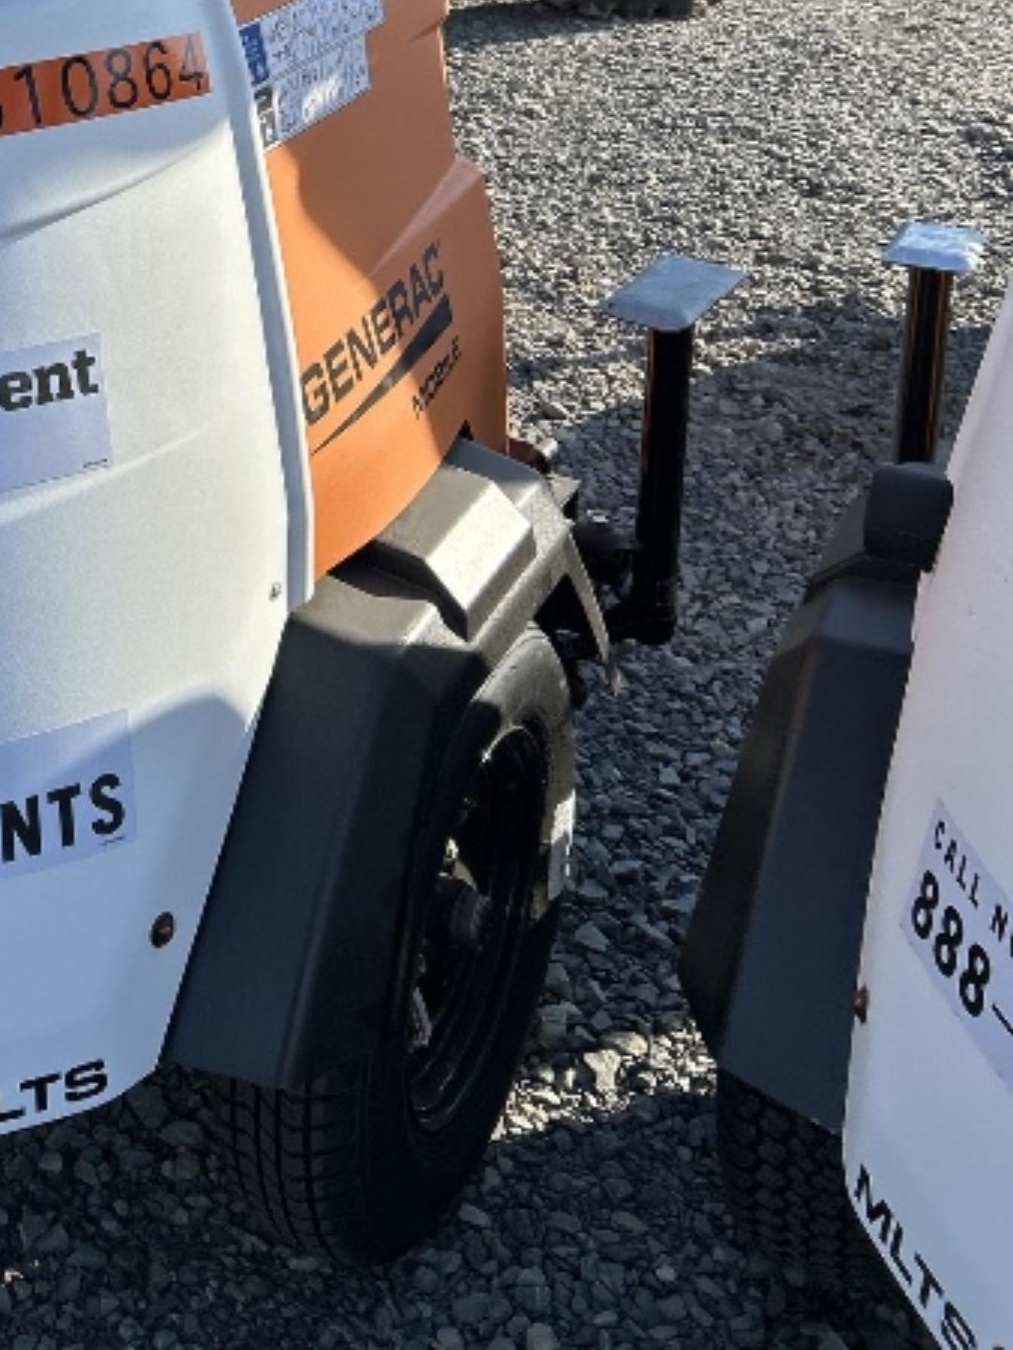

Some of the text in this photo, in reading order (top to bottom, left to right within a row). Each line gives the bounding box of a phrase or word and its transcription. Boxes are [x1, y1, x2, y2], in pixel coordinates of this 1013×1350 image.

[303, 243, 444, 424] GENERAC
[933, 820, 980, 910] CALL
[854, 1163, 978, 1350] MLTS
